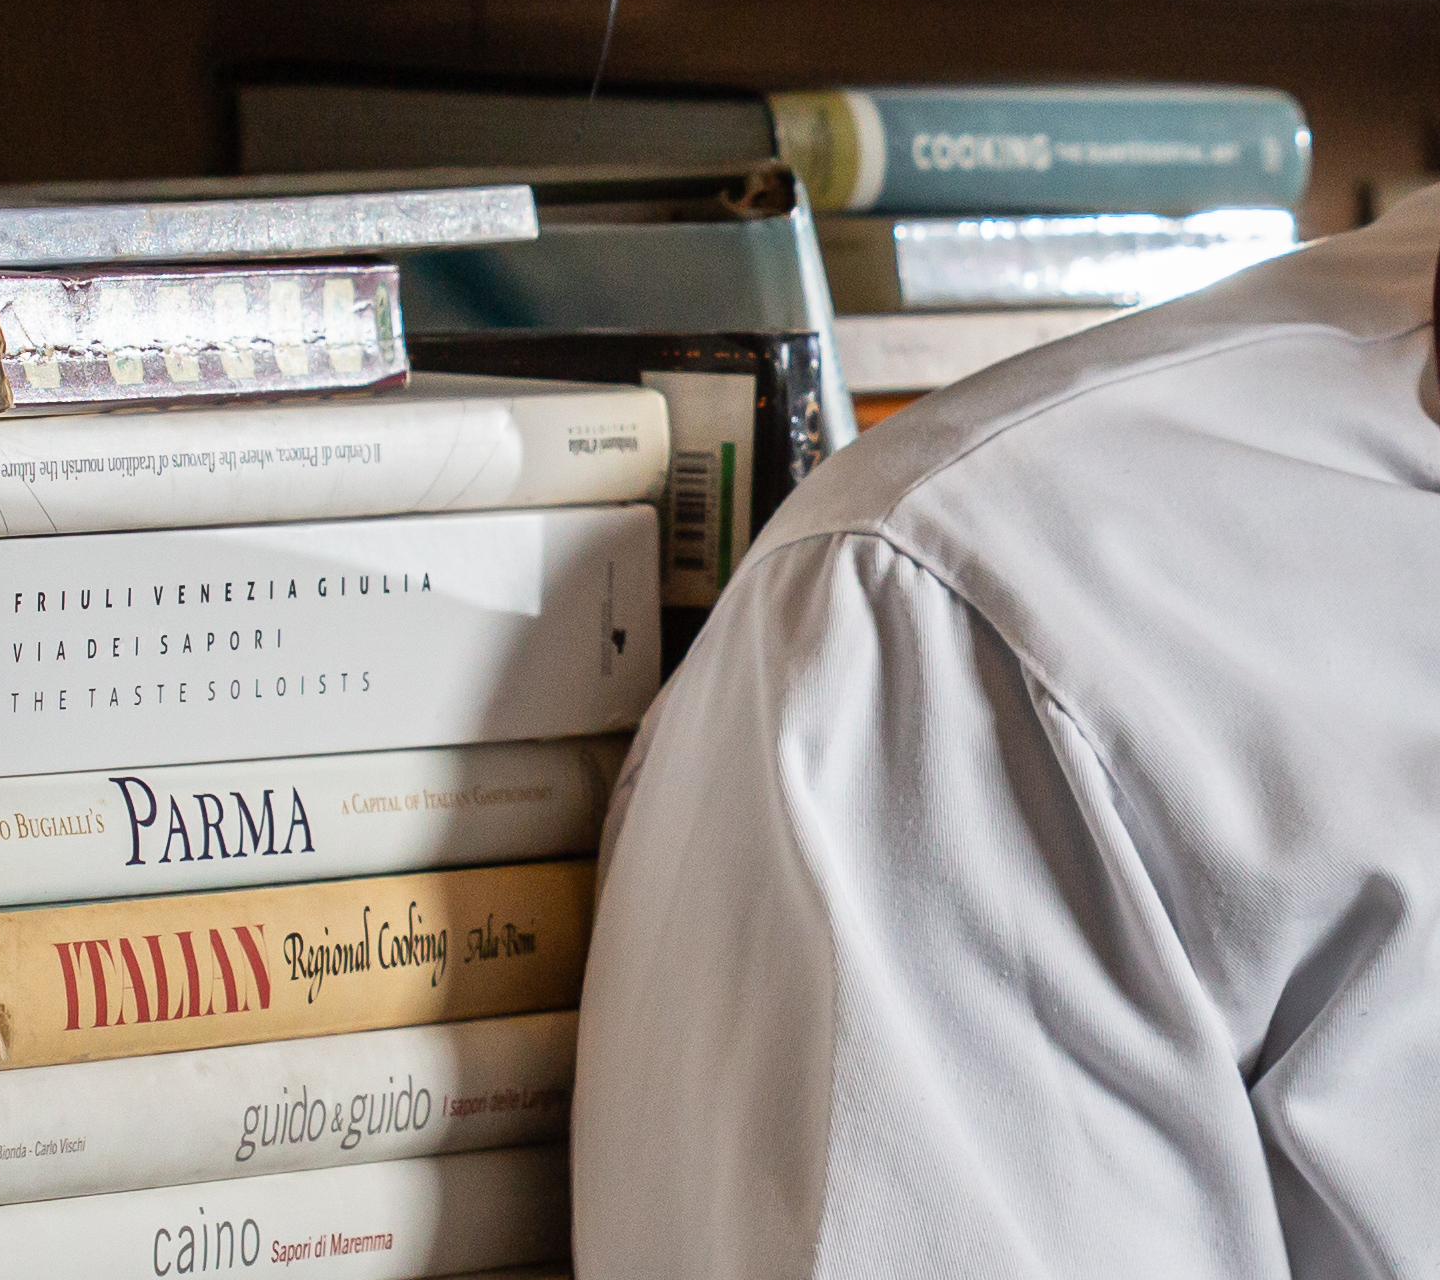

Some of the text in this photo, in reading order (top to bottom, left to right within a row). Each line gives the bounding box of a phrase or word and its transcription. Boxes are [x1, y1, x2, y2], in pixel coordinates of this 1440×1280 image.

[912, 132, 1053, 171] COOKING
[0, 443, 372, 484] Centro where the flavours tradition nourish the future
[13, 572, 433, 613] FRIULI VENEZIA GIULIA
[12, 628, 283, 663] VIA DEI SAPORI
[10, 671, 372, 714] THE TASTE SOLOISTS
[108, 775, 316, 867] PARMA
[351, 787, 469, 817] CAPITAL ITALIAN
[12, 808, 106, 841] BUGIALLI'S
[53, 900, 448, 1032] ITALIAN Regional Cooking
[34, 1138, 59, 1158] Carlo
[59, 1135, 86, 1155] Vischi
[152, 1206, 394, 1278] caino Sapori di Maremma
